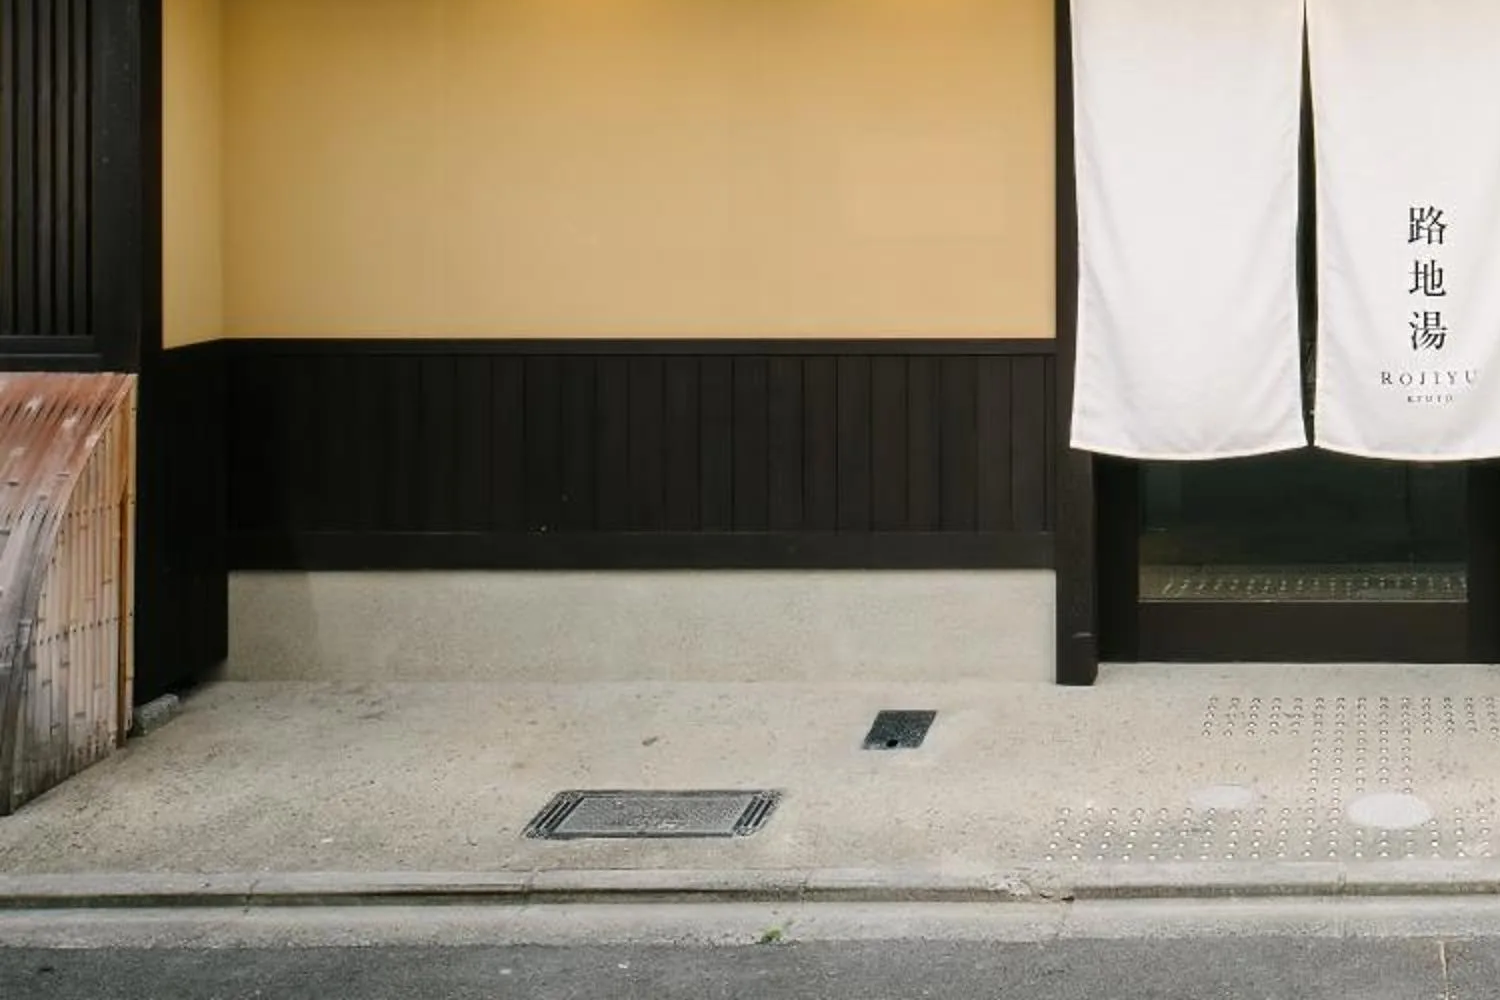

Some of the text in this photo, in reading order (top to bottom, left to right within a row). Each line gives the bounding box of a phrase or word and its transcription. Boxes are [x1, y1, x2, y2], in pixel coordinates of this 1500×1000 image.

[1407, 205, 1448, 350] 路地湯
[1381, 370, 1477, 385] ROJIYU
